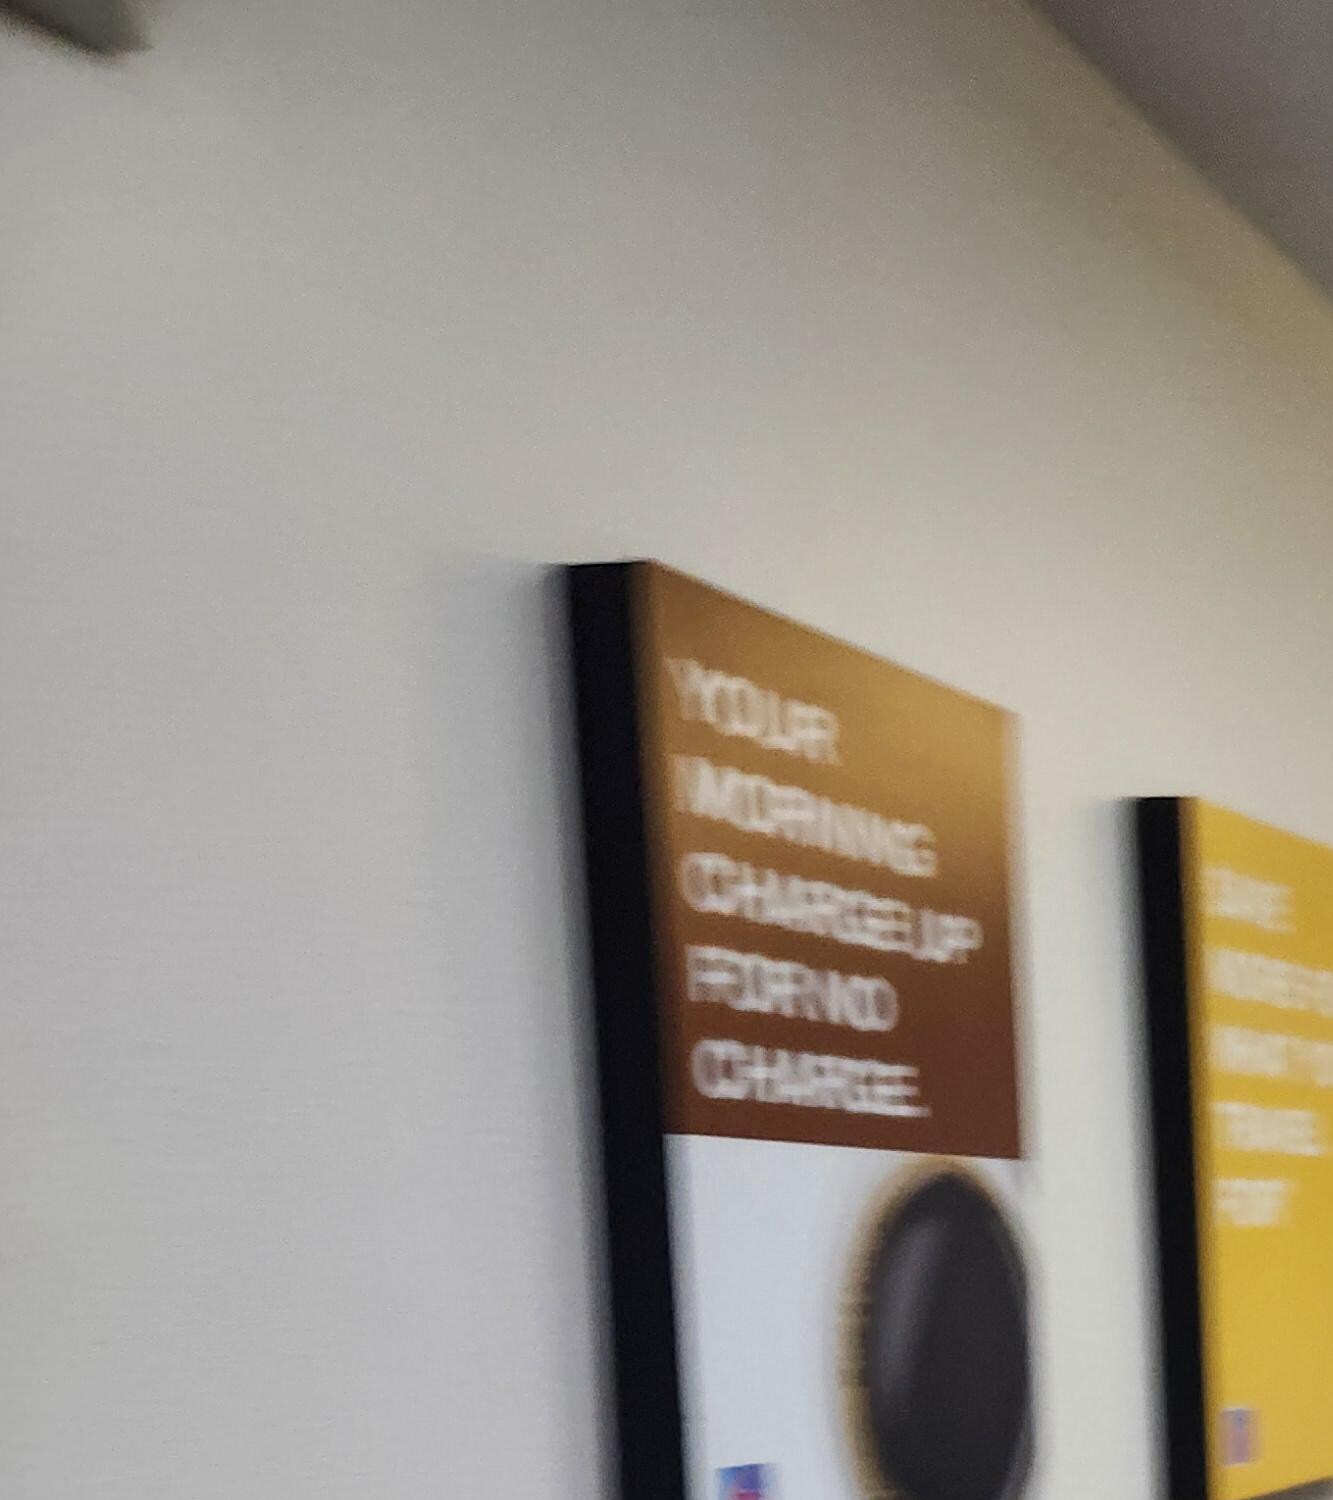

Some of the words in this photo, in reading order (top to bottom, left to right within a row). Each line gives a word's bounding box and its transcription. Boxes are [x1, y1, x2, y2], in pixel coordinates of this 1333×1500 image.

[666, 657, 841, 766] YOUR
[670, 754, 938, 878] MORNING
[679, 851, 914, 954] CHARGE
[909, 906, 984, 964] UP
[684, 943, 816, 1021] FOR
[807, 968, 898, 1032] NO
